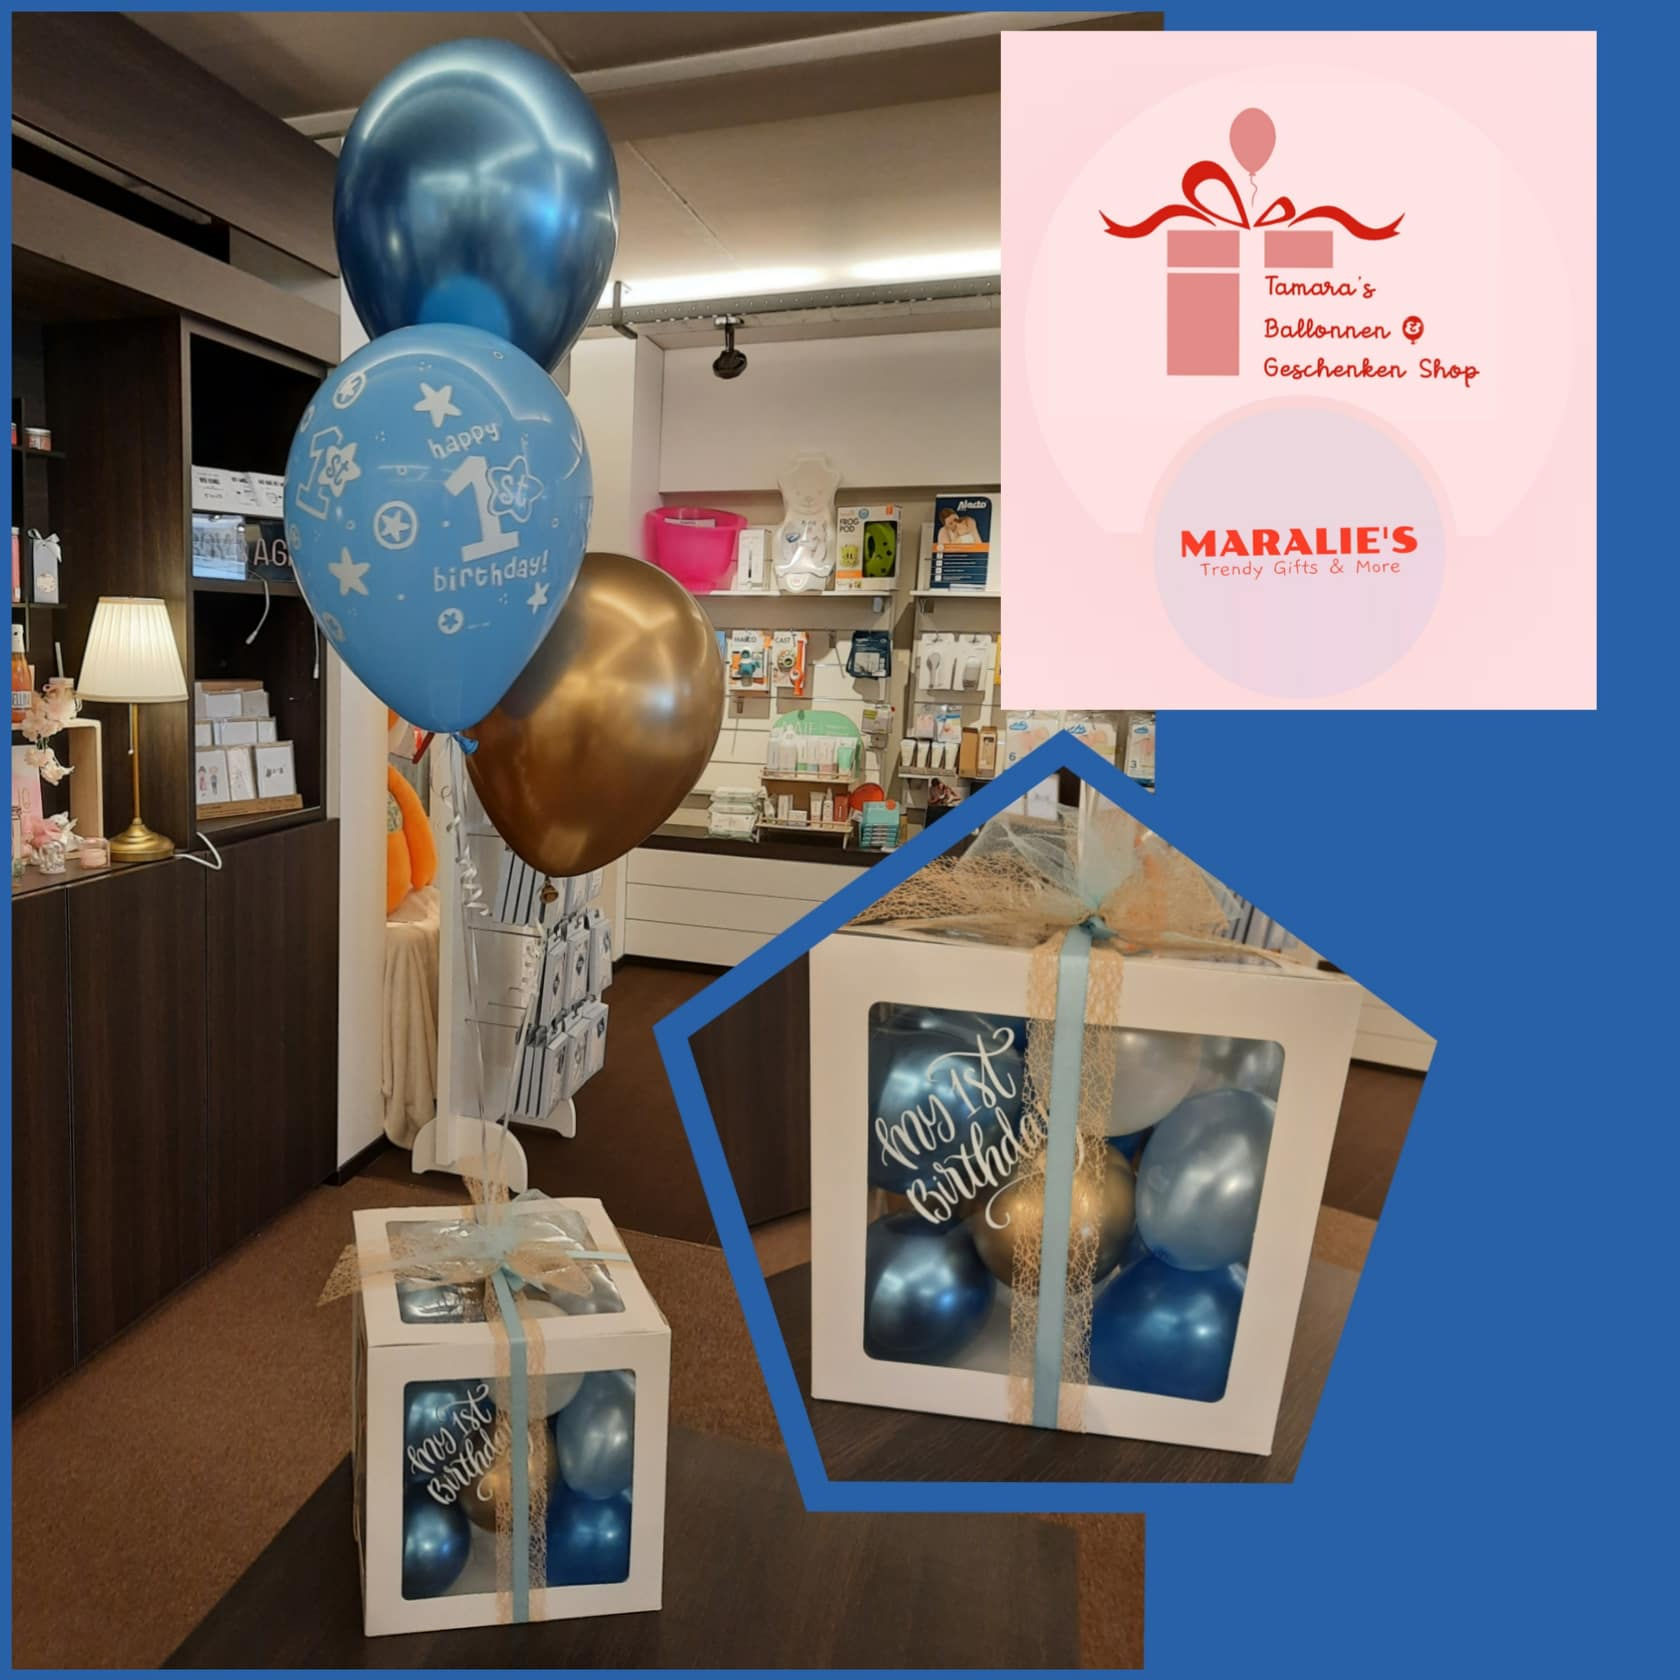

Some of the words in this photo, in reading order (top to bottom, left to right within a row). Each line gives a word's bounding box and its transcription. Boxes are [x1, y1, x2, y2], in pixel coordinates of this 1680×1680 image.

[428, 421, 501, 460] happy
[957, 500, 987, 511] Alecto
[840, 518, 860, 526] FROG
[839, 525, 855, 533] POD
[253, 537, 292, 566] AG
[433, 549, 551, 593] birthday!
[1008, 752, 1017, 761] 6
[1130, 760, 1138, 768] 3
[926, 1027, 1016, 1120] 1st
